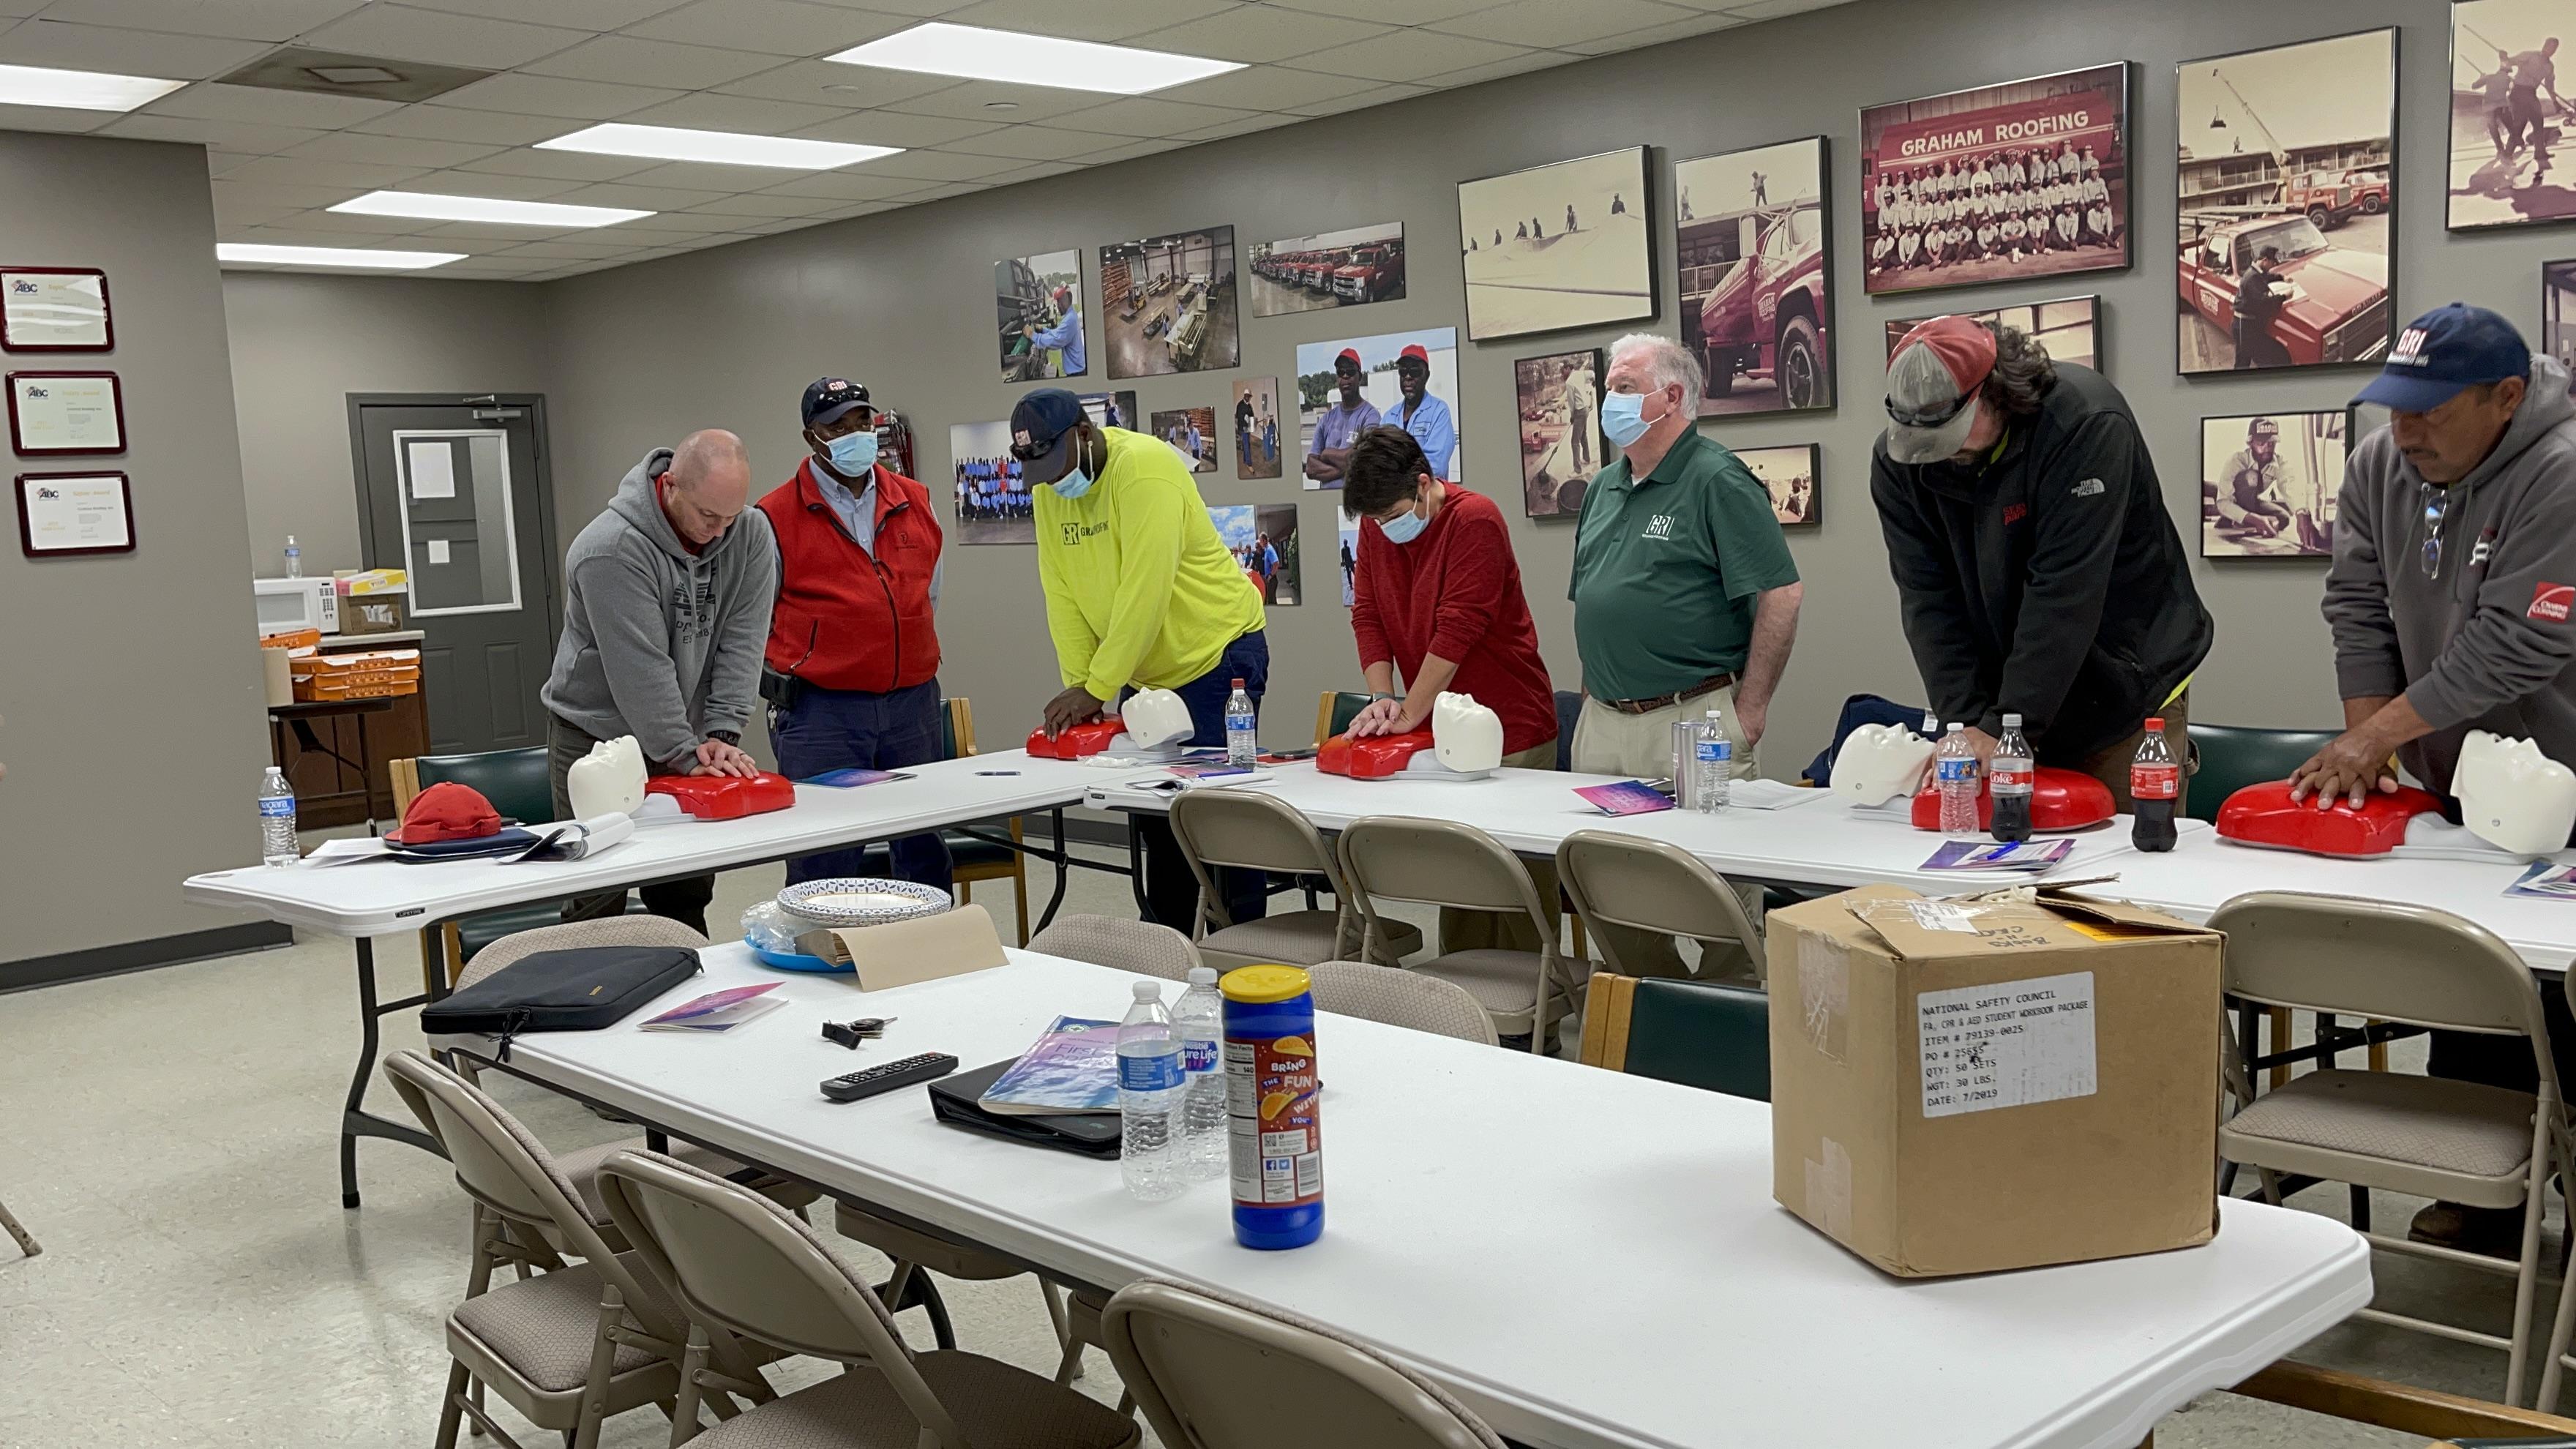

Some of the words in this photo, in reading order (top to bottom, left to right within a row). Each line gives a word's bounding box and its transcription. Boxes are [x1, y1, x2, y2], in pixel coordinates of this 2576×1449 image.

[1901, 127, 1983, 156] GRAHAM
[1996, 111, 2089, 141] ROOFING
[15, 283, 38, 293] ABC
[2397, 329, 2427, 355] GRI
[29, 389, 48, 397] ABC
[39, 490, 59, 500] ABC
[1991, 771, 2014, 785] Coke
[1922, 1002, 1970, 1016] NATIONAL
[1975, 996, 2011, 1010] SAFETY
[2015, 990, 2057, 1003] COUNCIL
[1941, 1018, 1955, 1030] CPR
[1966, 1015, 1982, 1026] AED
[1985, 1010, 2016, 1023] STUDENT
[2019, 1006, 2055, 1018] WORKBOOK
[2057, 1000, 2089, 1013] PACKAGE
[1925, 1035, 1950, 1046] ITEM
[1954, 1034, 1961, 1042] #
[1965, 1025, 2024, 1041] 79139-0025
[1055, 1043, 1098, 1056] First
[1185, 1049, 1199, 1059] ure
[1200, 1049, 1218, 1063] Life
[1925, 1052, 1939, 1061] PO
[1943, 1050, 1950, 1058] #
[1271, 1058, 1307, 1073] BRING
[1925, 1066, 1950, 1078] QTY:
[1955, 1063, 1968, 1073] 50
[1973, 1058, 1997, 1070] SETS
[1262, 1077, 1279, 1087] THE
[1283, 1074, 1312, 1088] FUN
[1926, 1081, 1950, 1092] WGT:
[1956, 1078, 1969, 1087] 30
[1974, 1074, 1996, 1085] LBS.
[1293, 1090, 1318, 1114] WITH
[1927, 1095, 1956, 1107] DATE:
[1963, 1088, 1998, 1102] 7/2019
